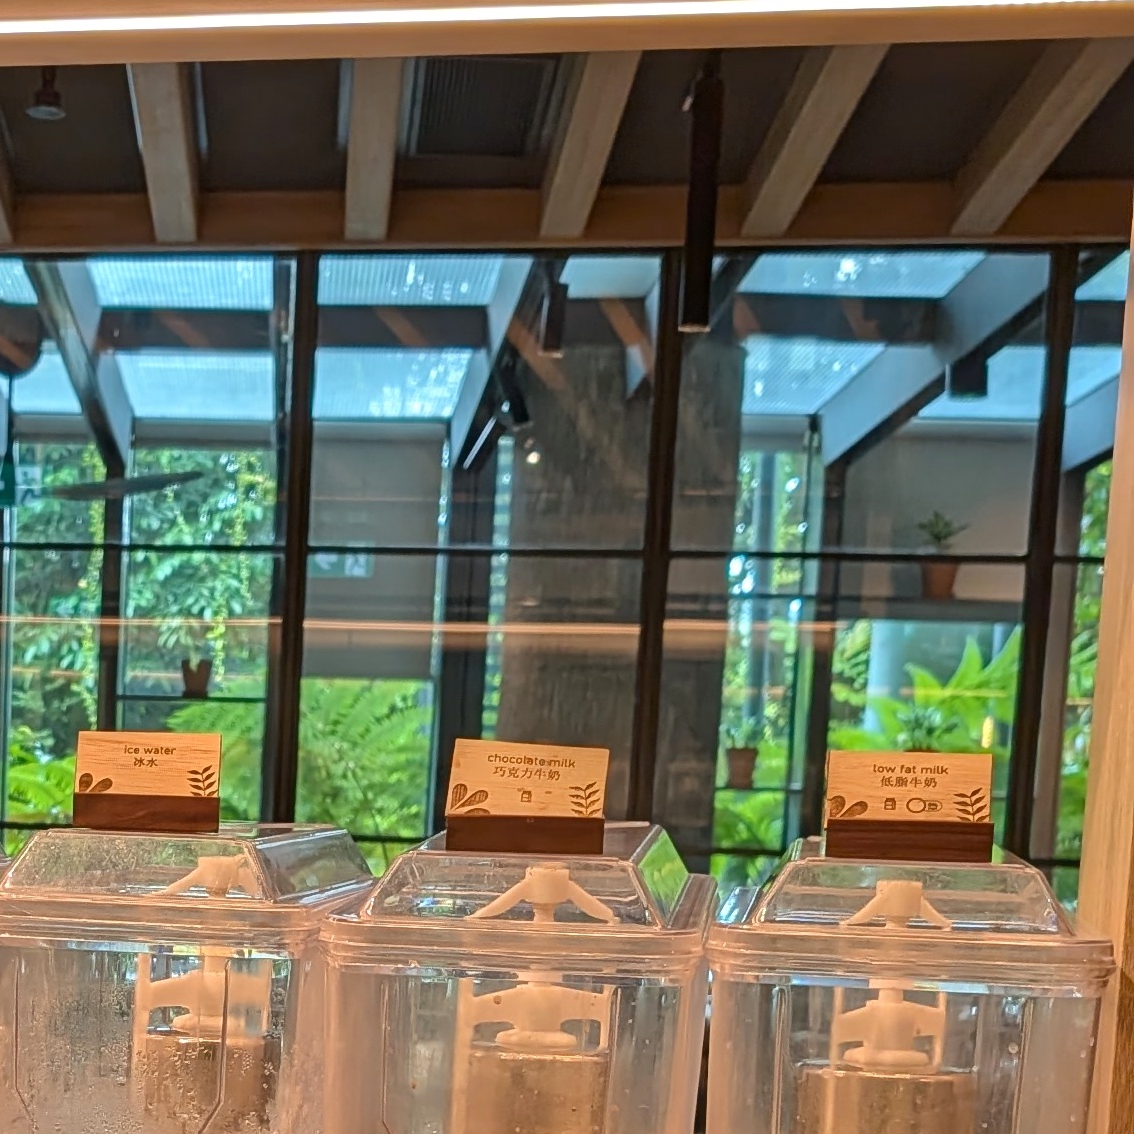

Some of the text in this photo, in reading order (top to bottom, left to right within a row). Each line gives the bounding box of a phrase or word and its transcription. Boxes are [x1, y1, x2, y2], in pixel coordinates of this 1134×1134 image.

[123, 745, 177, 755] ice water
[133, 757, 158, 768] 冰水
[487, 753, 576, 768] chocolate milk
[492, 766, 561, 781] 巧克力牛奶
[872, 763, 949, 775] low fat milk
[880, 775, 938, 788] 低脂牛奶
